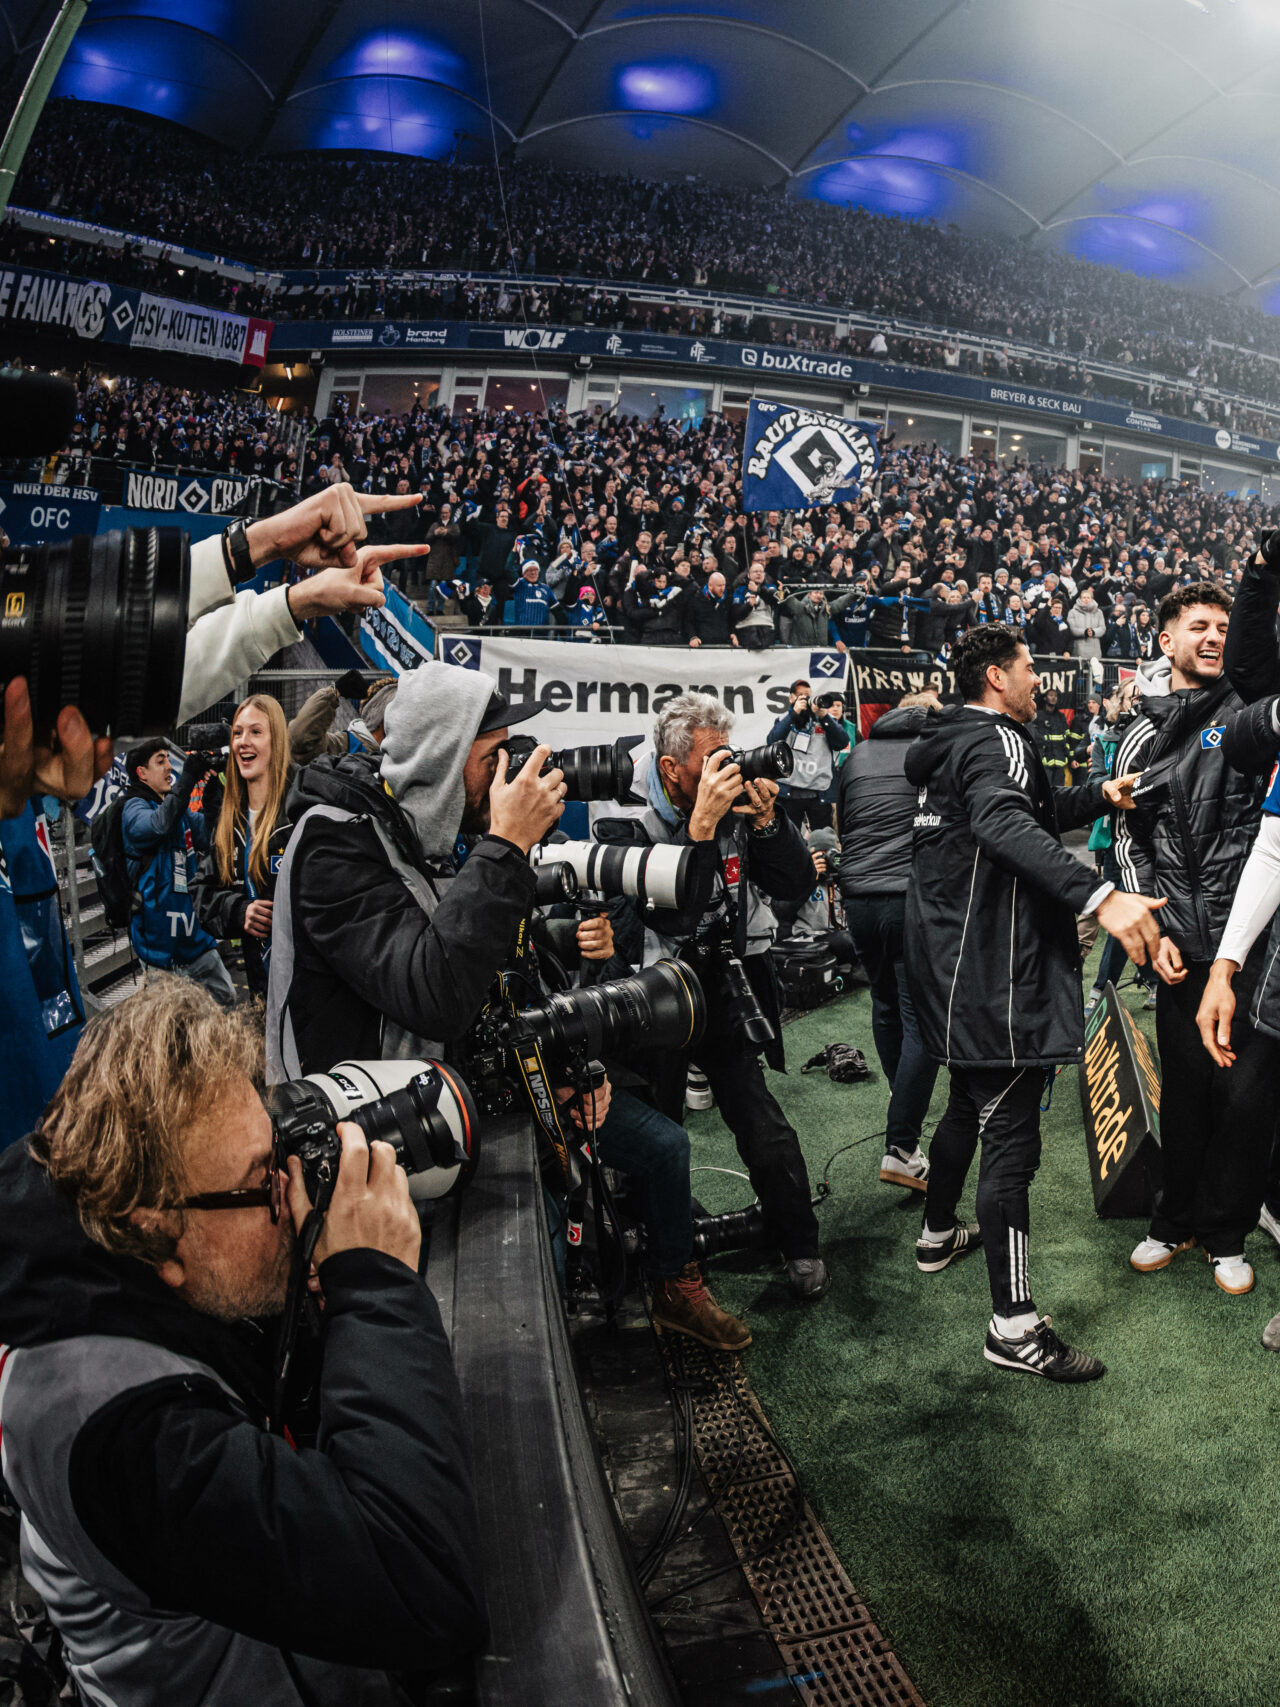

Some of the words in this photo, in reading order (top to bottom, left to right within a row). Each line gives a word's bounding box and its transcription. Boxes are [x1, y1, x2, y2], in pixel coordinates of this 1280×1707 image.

[0, 271, 15, 317] E
[135, 303, 217, 347] HSV-KUTTEN
[220, 320, 247, 353] 1887
[405, 337, 446, 345] Hamburg
[407, 328, 448, 337] brand
[504, 329, 566, 349] WOLF
[762, 354, 853, 378] buXtrade
[990, 387, 1026, 404] BREYER
[1028, 394, 1036, 405] &
[1037, 397, 1060, 410] SECK
[1063, 401, 1082, 414] BAU
[13, 483, 42, 496] NUR
[44, 485, 71, 499] DER
[72, 488, 98, 502] HSV
[127, 472, 179, 511] NORD
[30, 506, 70, 529] OFC
[166, 911, 195, 937] TV
[517, 918, 526, 945] Nikon
[515, 945, 524, 959] Z
[529, 1073, 551, 1110] NPS
[1085, 1015, 1132, 1181] buXtrade
